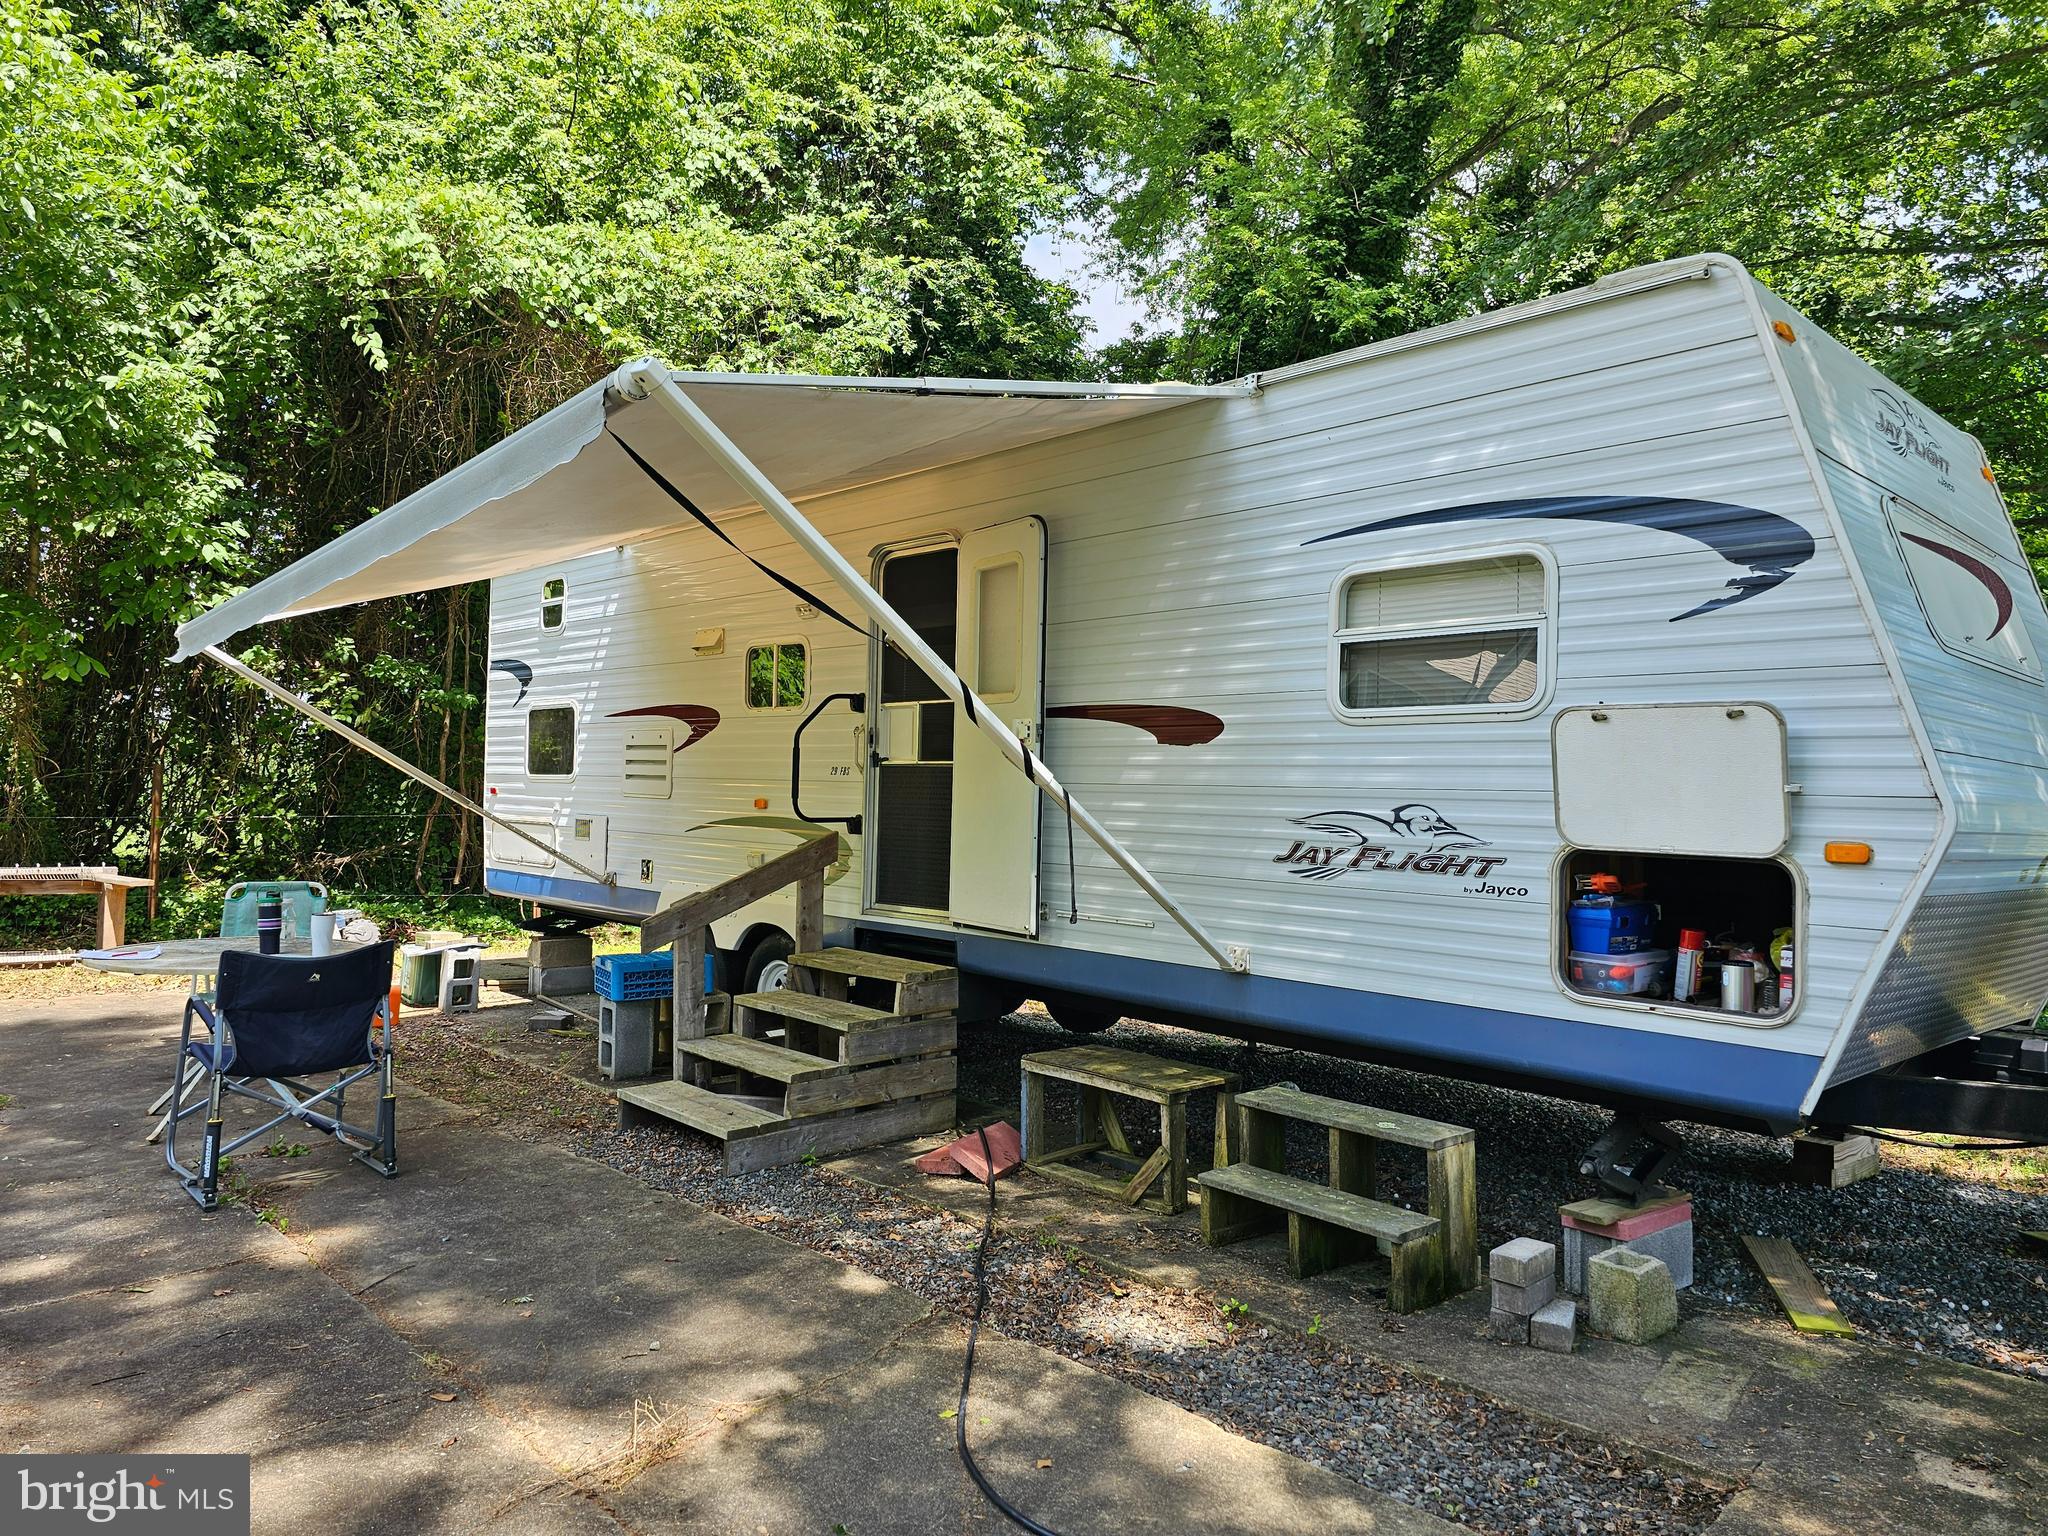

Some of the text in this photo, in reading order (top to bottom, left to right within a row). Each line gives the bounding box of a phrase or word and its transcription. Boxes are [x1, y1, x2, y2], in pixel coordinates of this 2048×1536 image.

[1273, 841, 1507, 878] JAY FLIGHT
[1463, 882, 1529, 898] by Jayco
